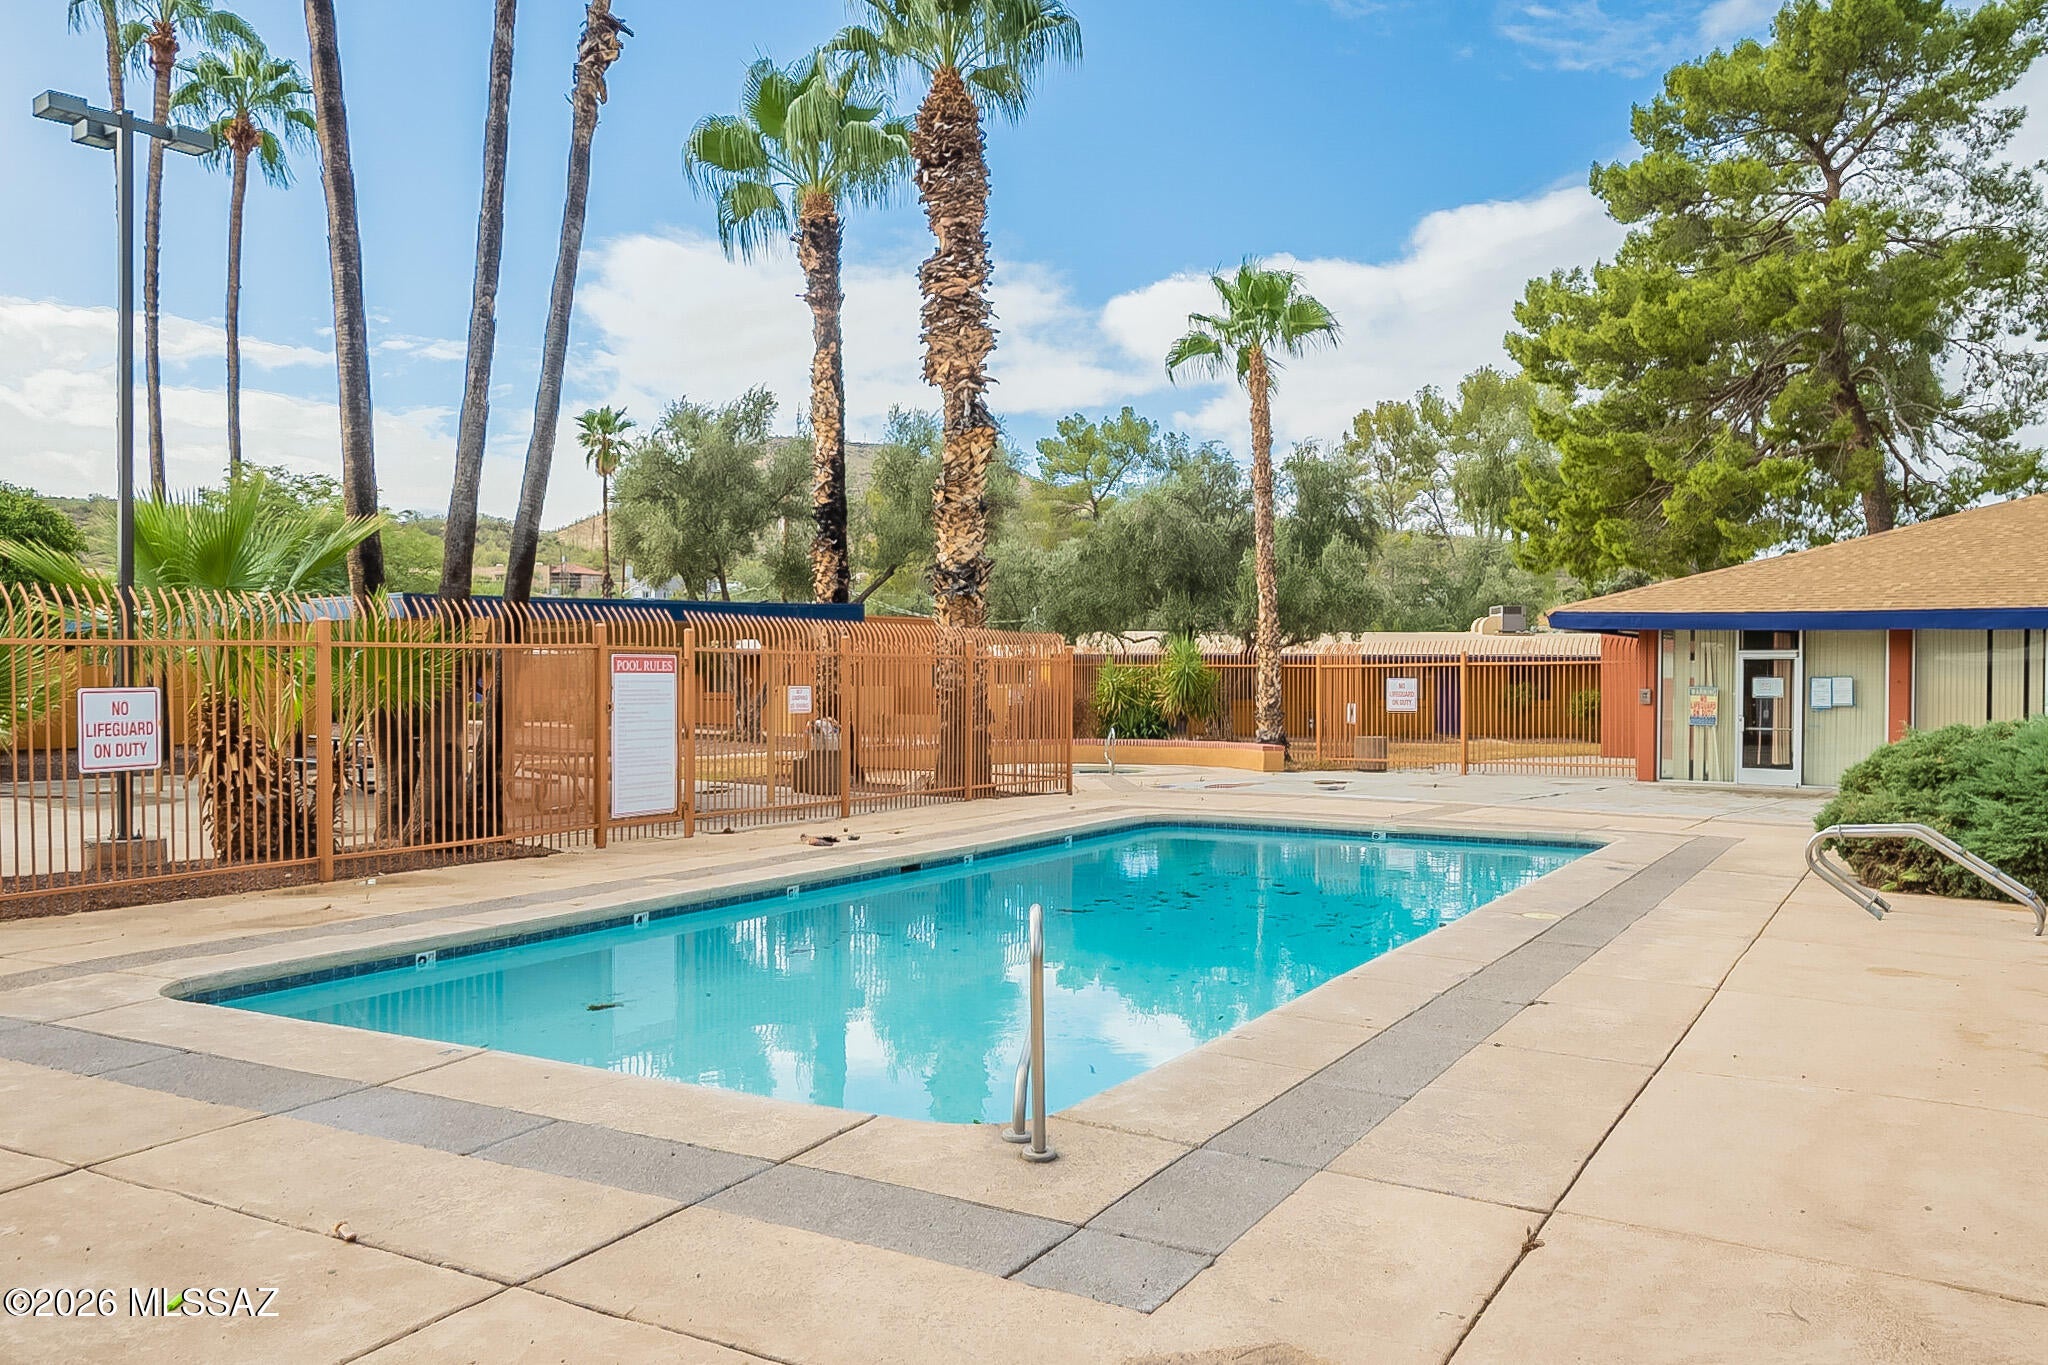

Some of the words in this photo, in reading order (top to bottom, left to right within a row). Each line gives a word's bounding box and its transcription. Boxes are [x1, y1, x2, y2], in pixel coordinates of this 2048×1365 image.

[616, 660, 642, 672] POOL
[643, 660, 673, 672] RULES
[111, 701, 129, 716] NO
[86, 721, 154, 738] LIFEGUARD
[94, 743, 111, 759] ON
[115, 741, 147, 758] DUTY
